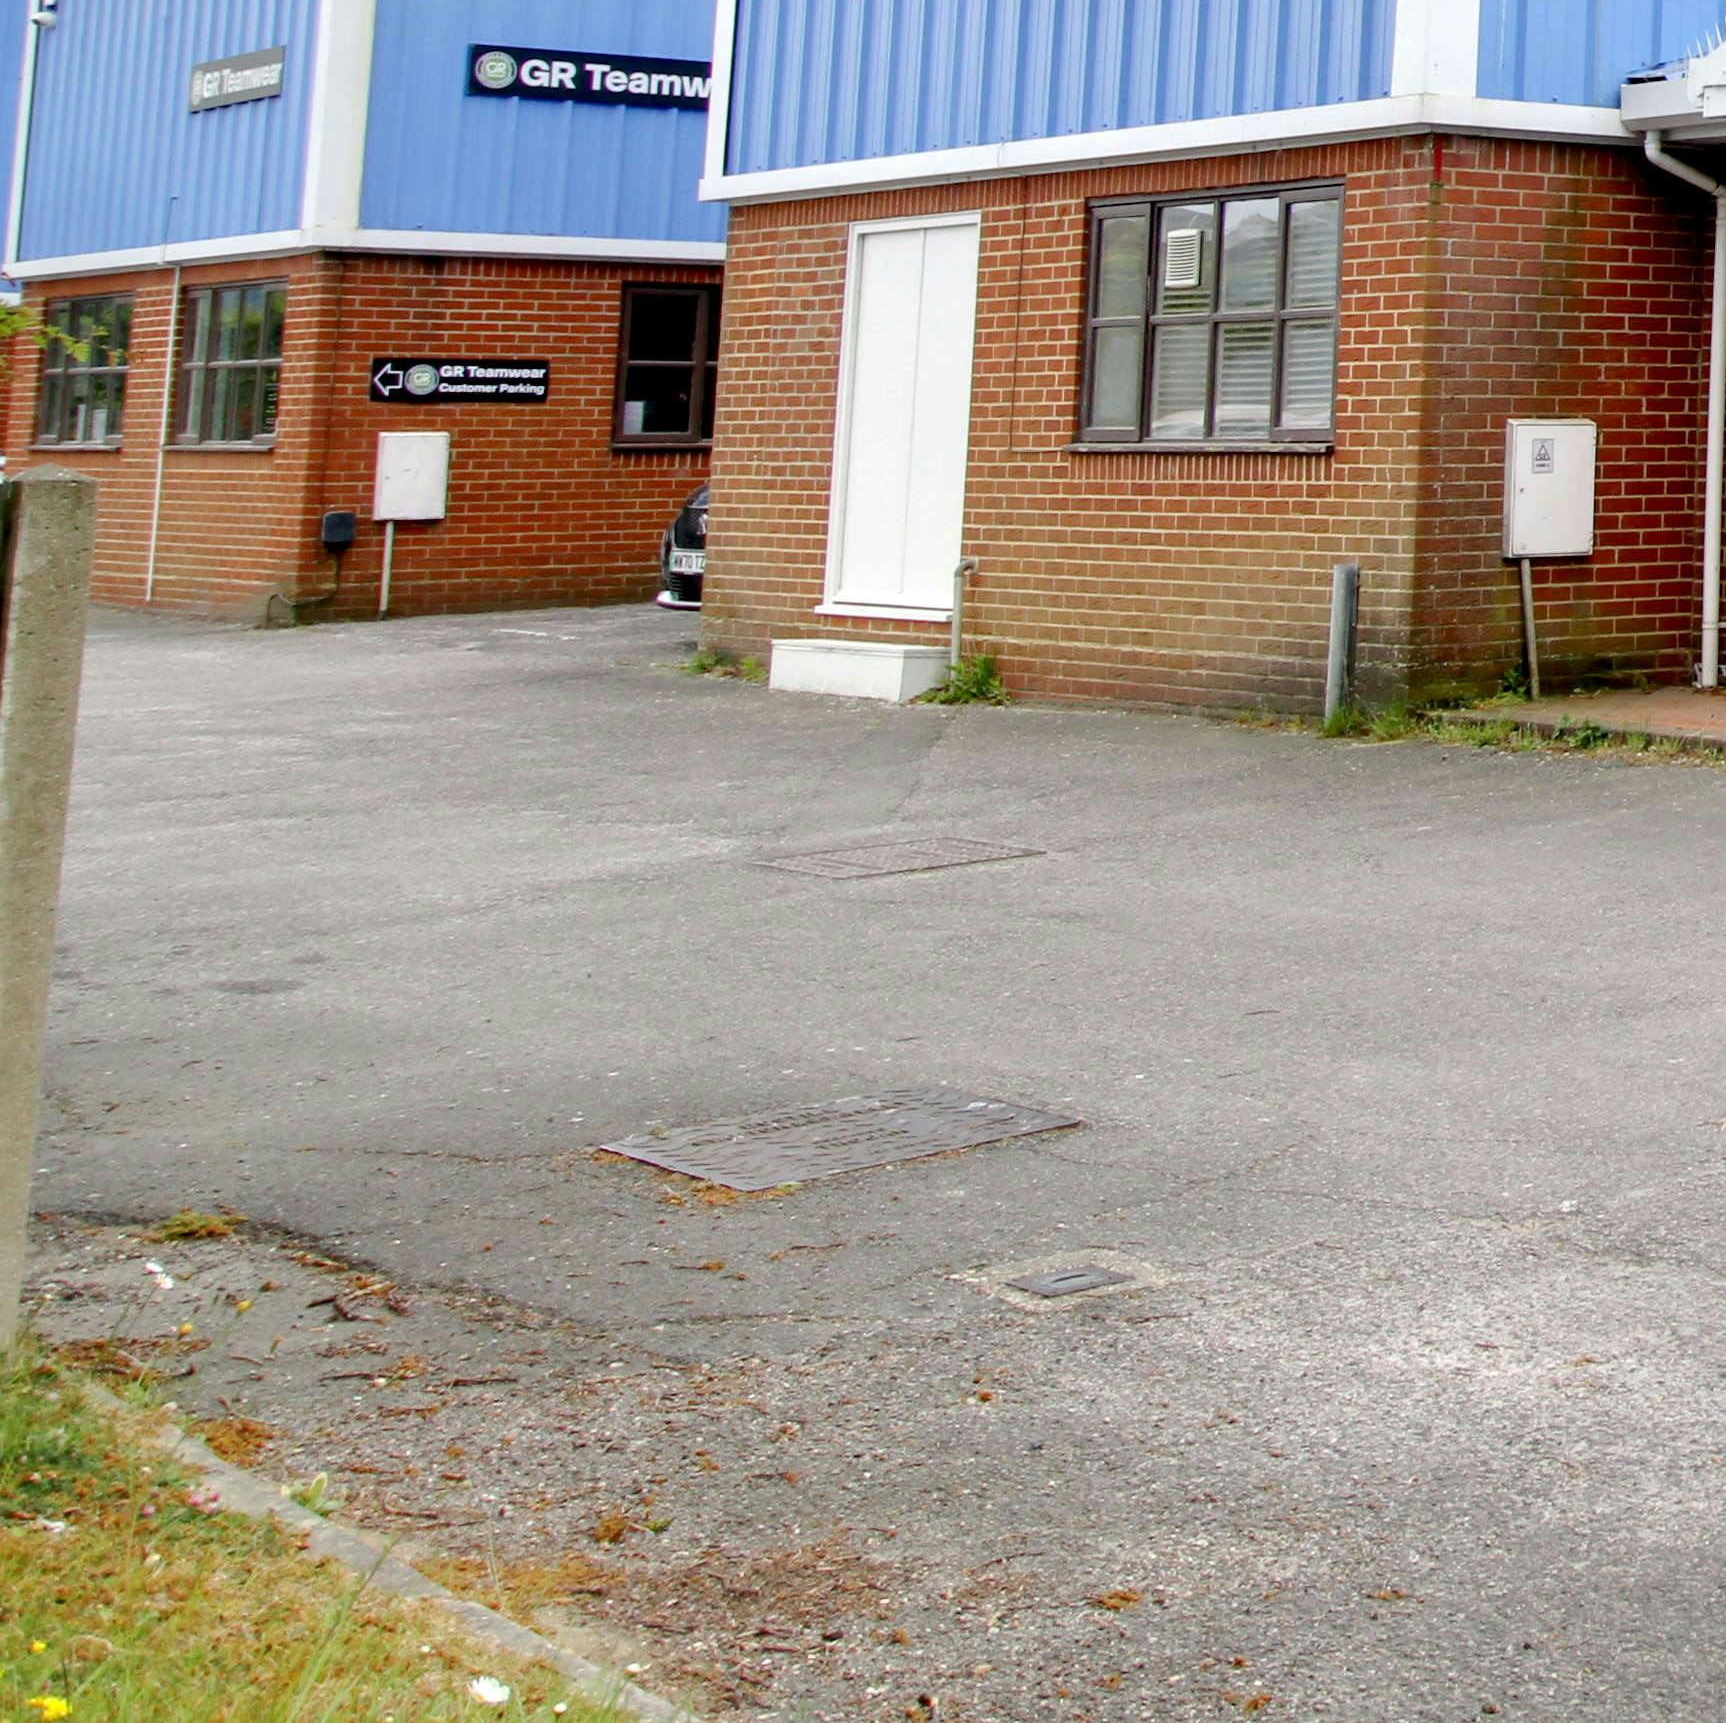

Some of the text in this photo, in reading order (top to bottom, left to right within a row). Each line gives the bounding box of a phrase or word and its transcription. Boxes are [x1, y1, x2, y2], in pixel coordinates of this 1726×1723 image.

[221, 62, 283, 94] Teamwear
[520, 59, 713, 97] GR Teamw
[439, 365, 546, 379] GR Teamwear
[438, 382, 545, 396] Customer Parking
